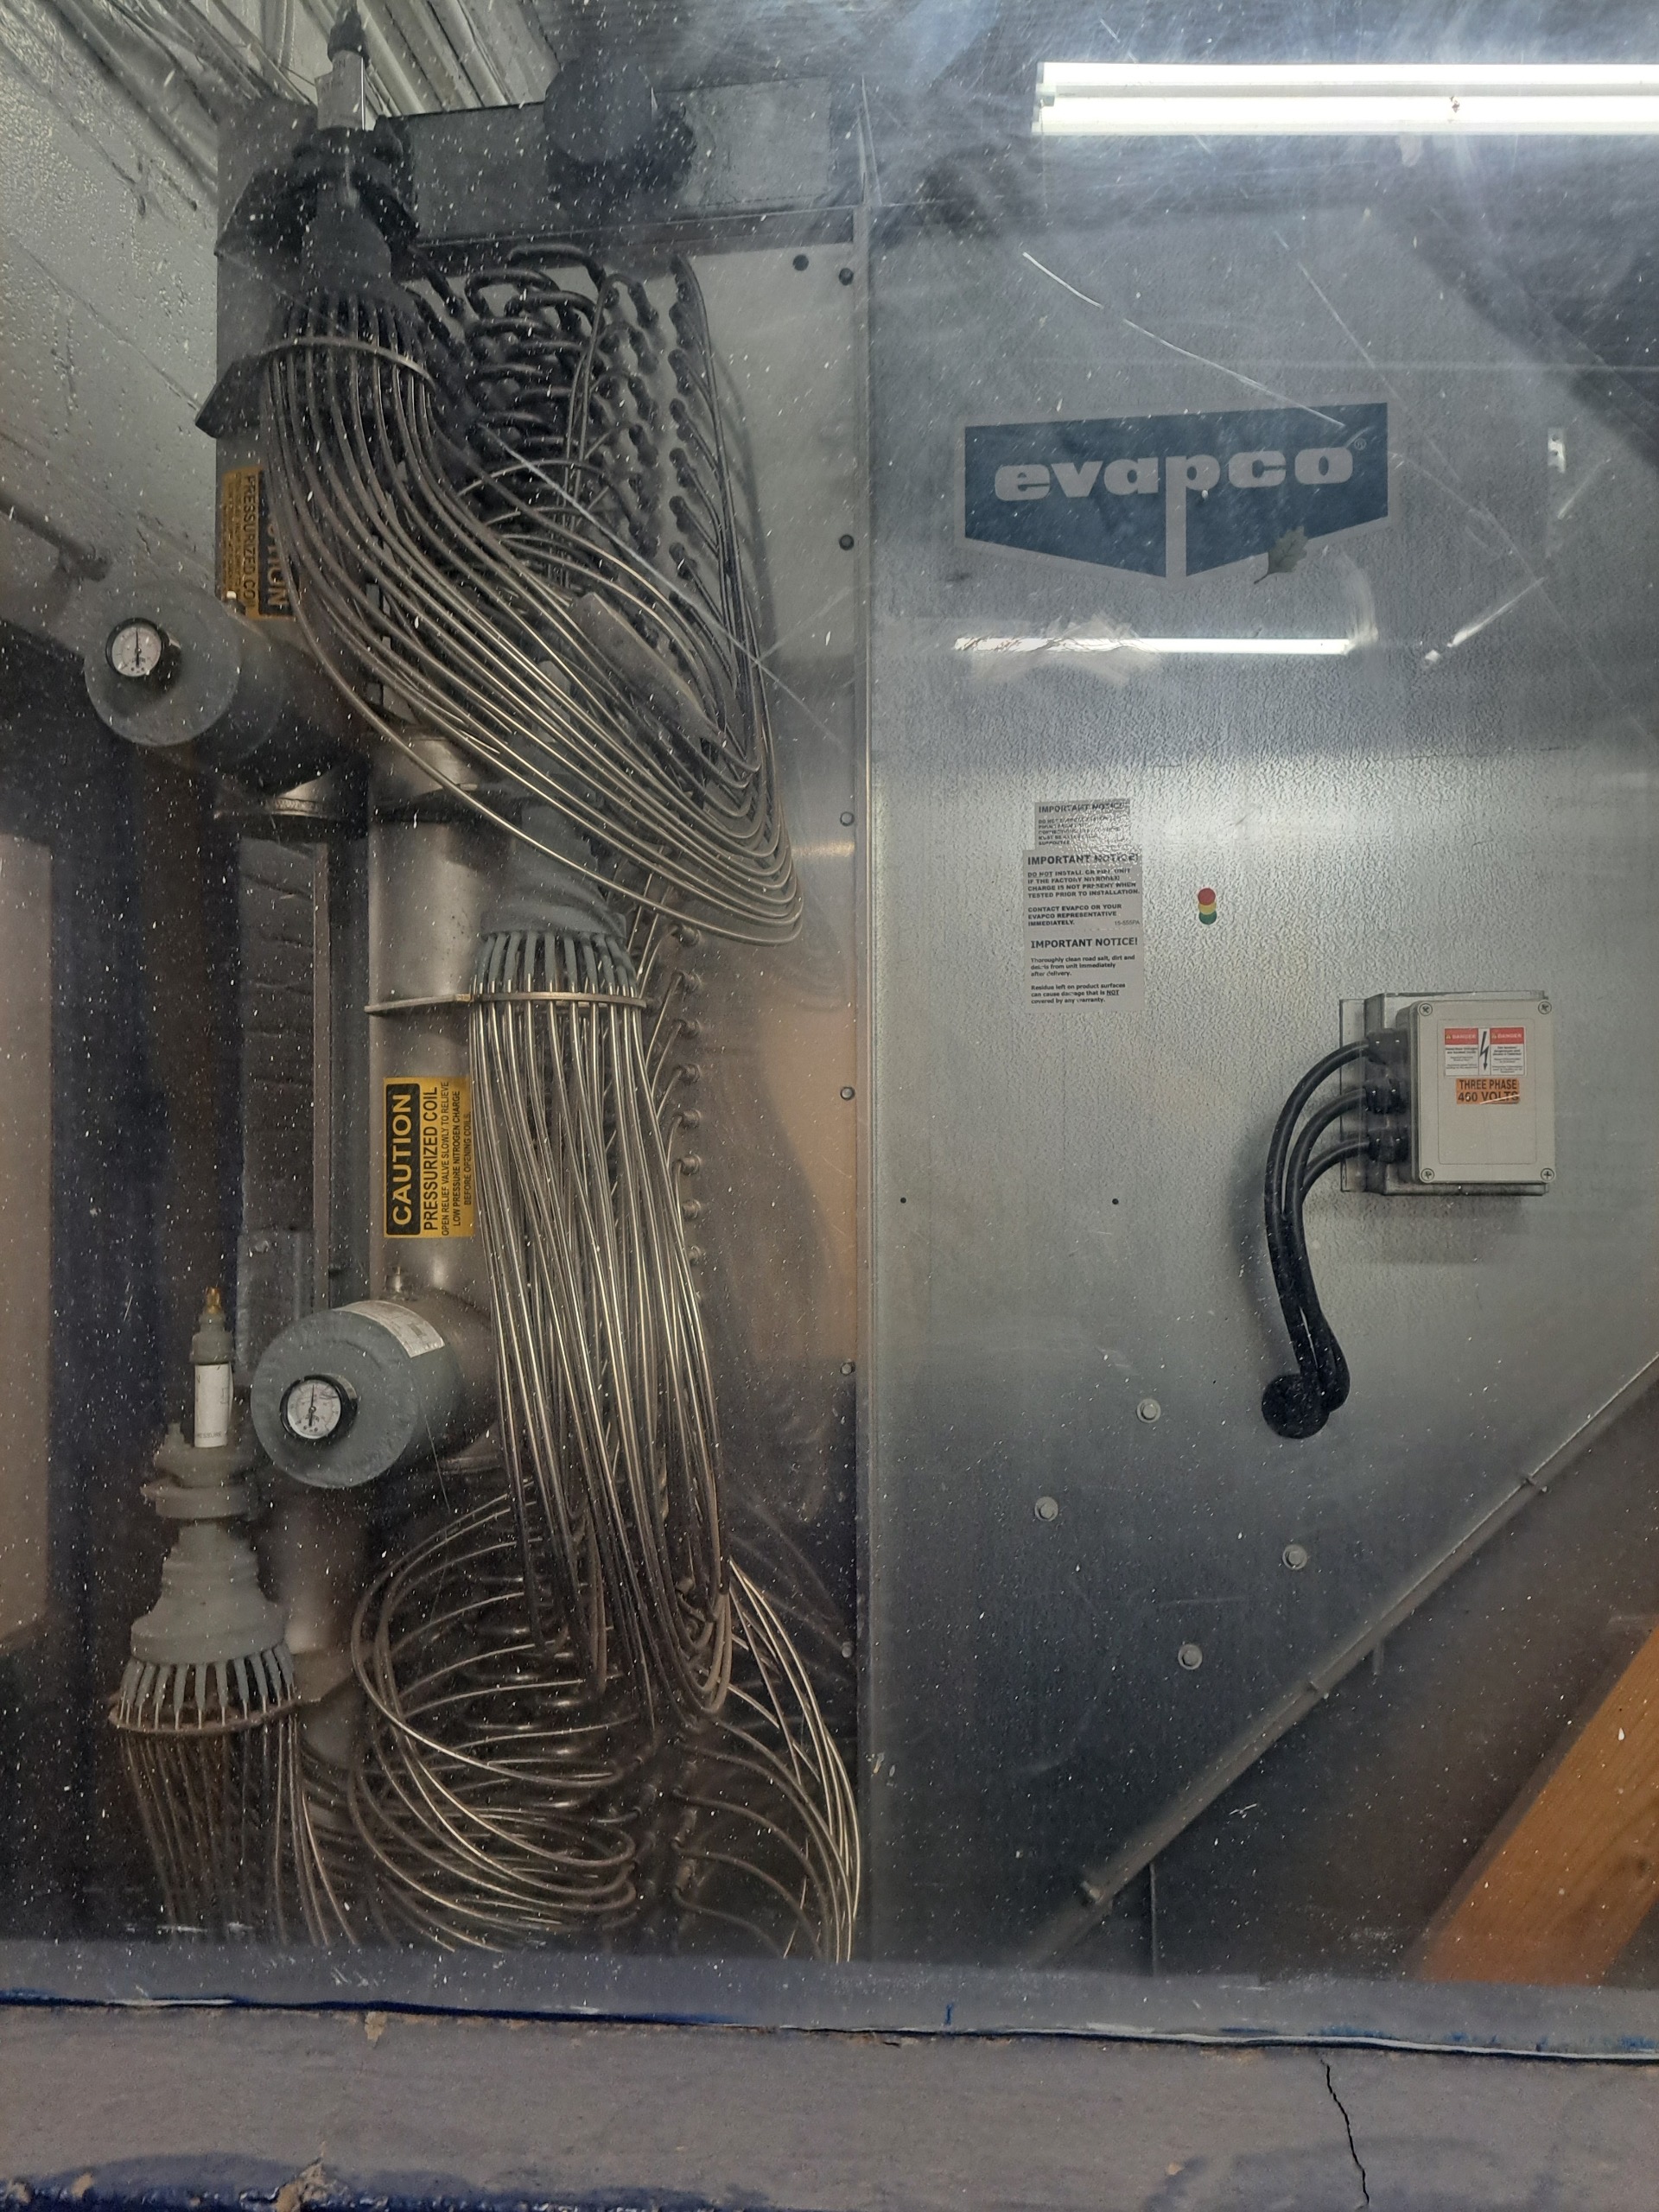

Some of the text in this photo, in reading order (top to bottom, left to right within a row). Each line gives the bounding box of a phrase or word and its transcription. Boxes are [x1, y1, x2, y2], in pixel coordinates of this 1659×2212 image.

[243, 475, 257, 575] PRESSURIZED
[1028, 855, 1090, 865] IMPORTANT
[1031, 937, 1138, 949] IMPORTANT NOTICE!
[1458, 1091, 1519, 1103] 460 VOLTS
[1459, 1078, 1516, 1090] THREE PHASE
[392, 1094, 412, 1225] CAUTION
[423, 1087, 438, 1230] PRESSURIZED COIL
[441, 1082, 450, 1236] OPEN RELIEF VALVE SLOWLY TO RELIEVE
[452, 1090, 461, 1227] LOW PRESSURE NITROGEN CHARGE
[463, 1111, 472, 1205] BEFORE OPENING COILS.
